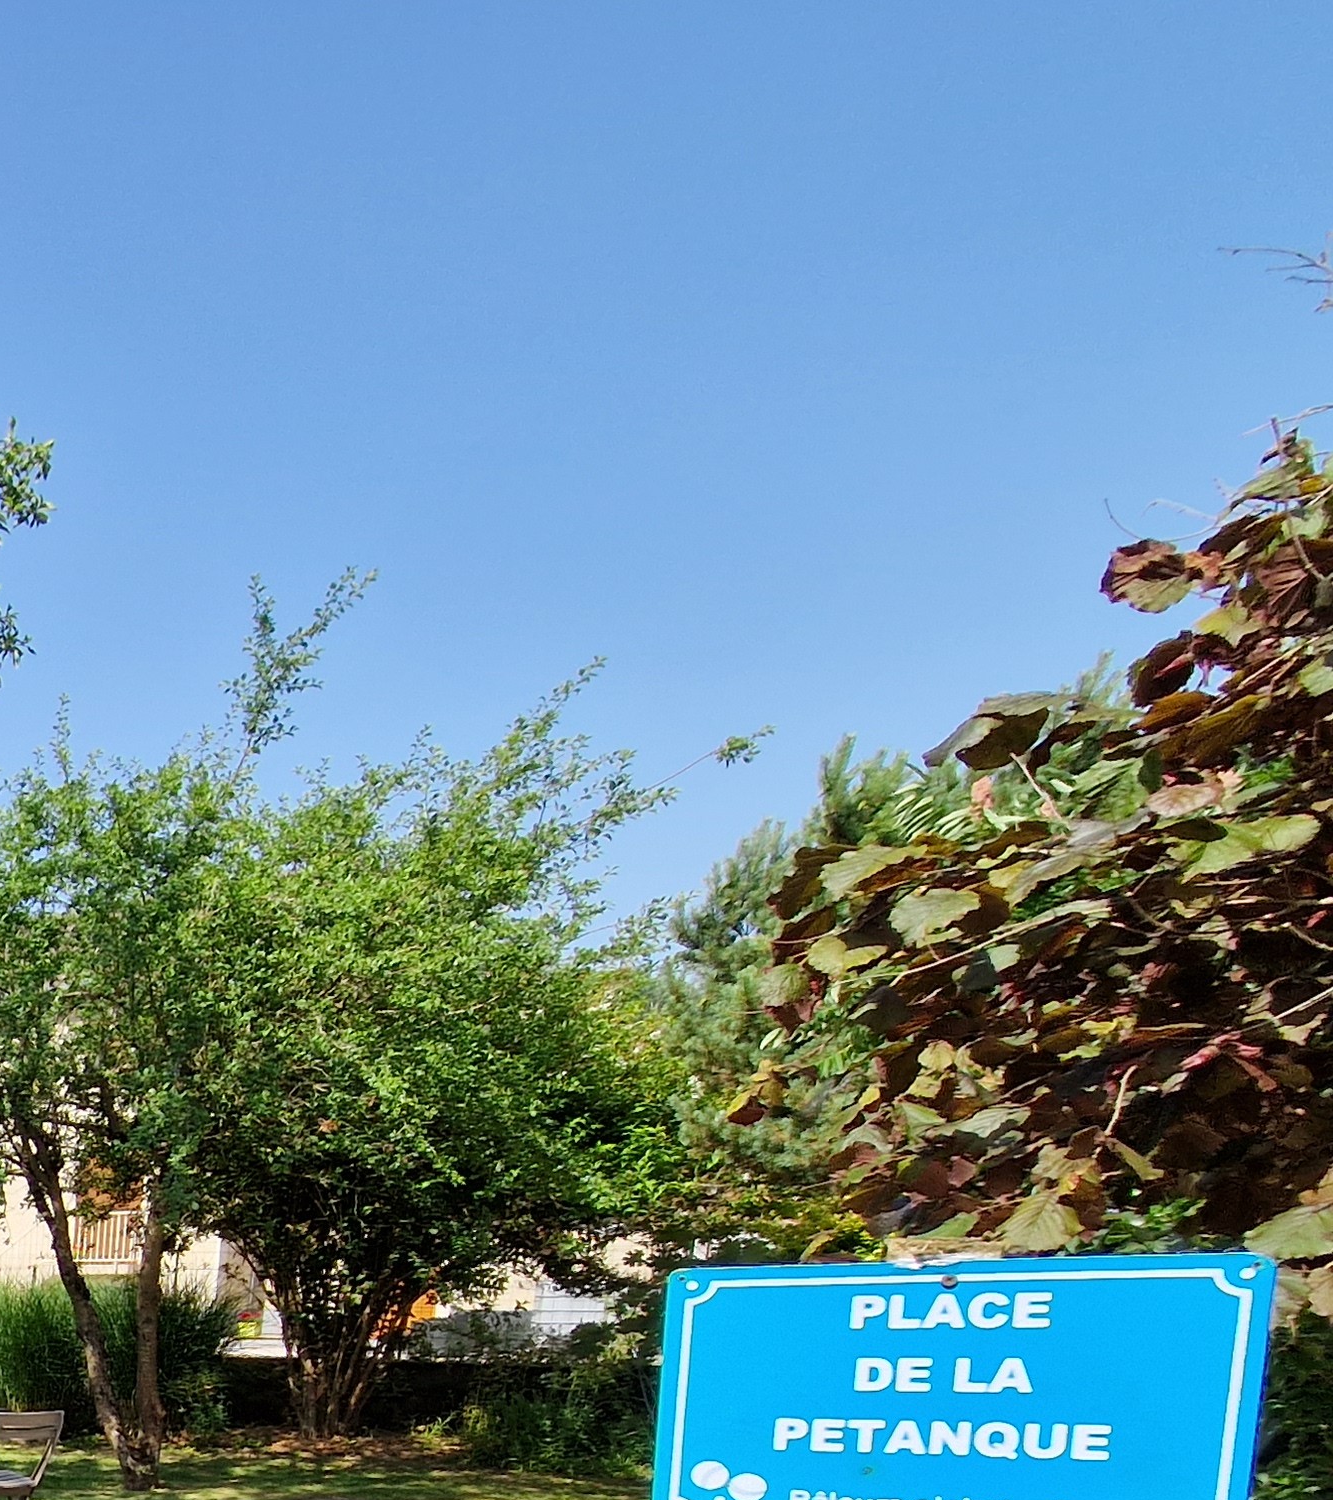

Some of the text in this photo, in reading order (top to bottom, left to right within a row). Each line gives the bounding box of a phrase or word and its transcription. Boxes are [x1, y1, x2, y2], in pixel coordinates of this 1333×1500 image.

[848, 1291, 1054, 1330] PLACE
[853, 1356, 1034, 1394] DE LA
[772, 1416, 1112, 1461] PETANQUE
